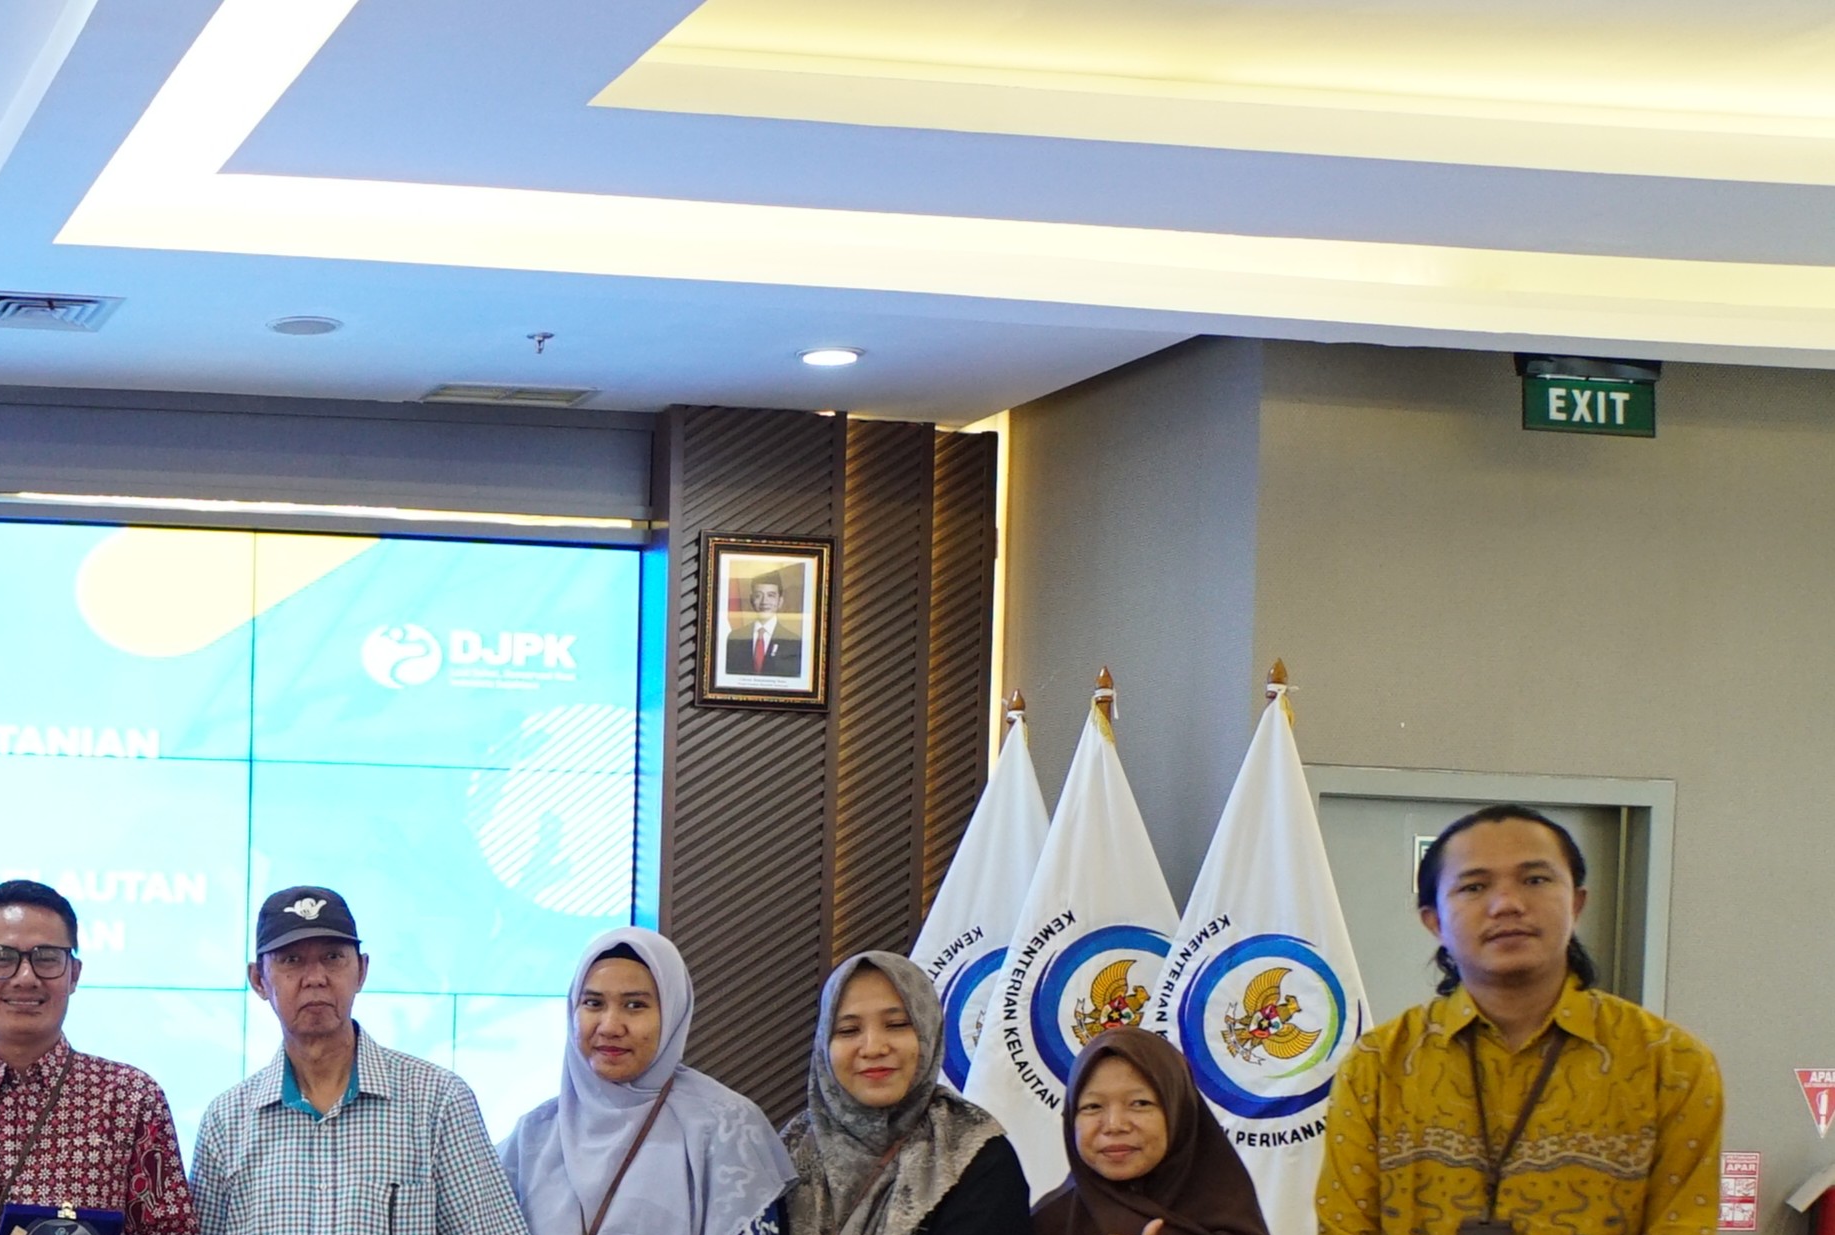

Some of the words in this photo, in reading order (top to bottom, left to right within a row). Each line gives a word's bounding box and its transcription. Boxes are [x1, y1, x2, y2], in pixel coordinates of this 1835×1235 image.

[1548, 387, 1631, 425] EXIT
[449, 629, 577, 668] DJPK
[927, 925, 985, 985] KEMENT
[1003, 909, 1077, 1021] KEMENTERIAN
[1155, 913, 1232, 1022] KEMENTERIAN
[1003, 1026, 1061, 1110] KELAUTAN
[1726, 1163, 1757, 1172] APAR
